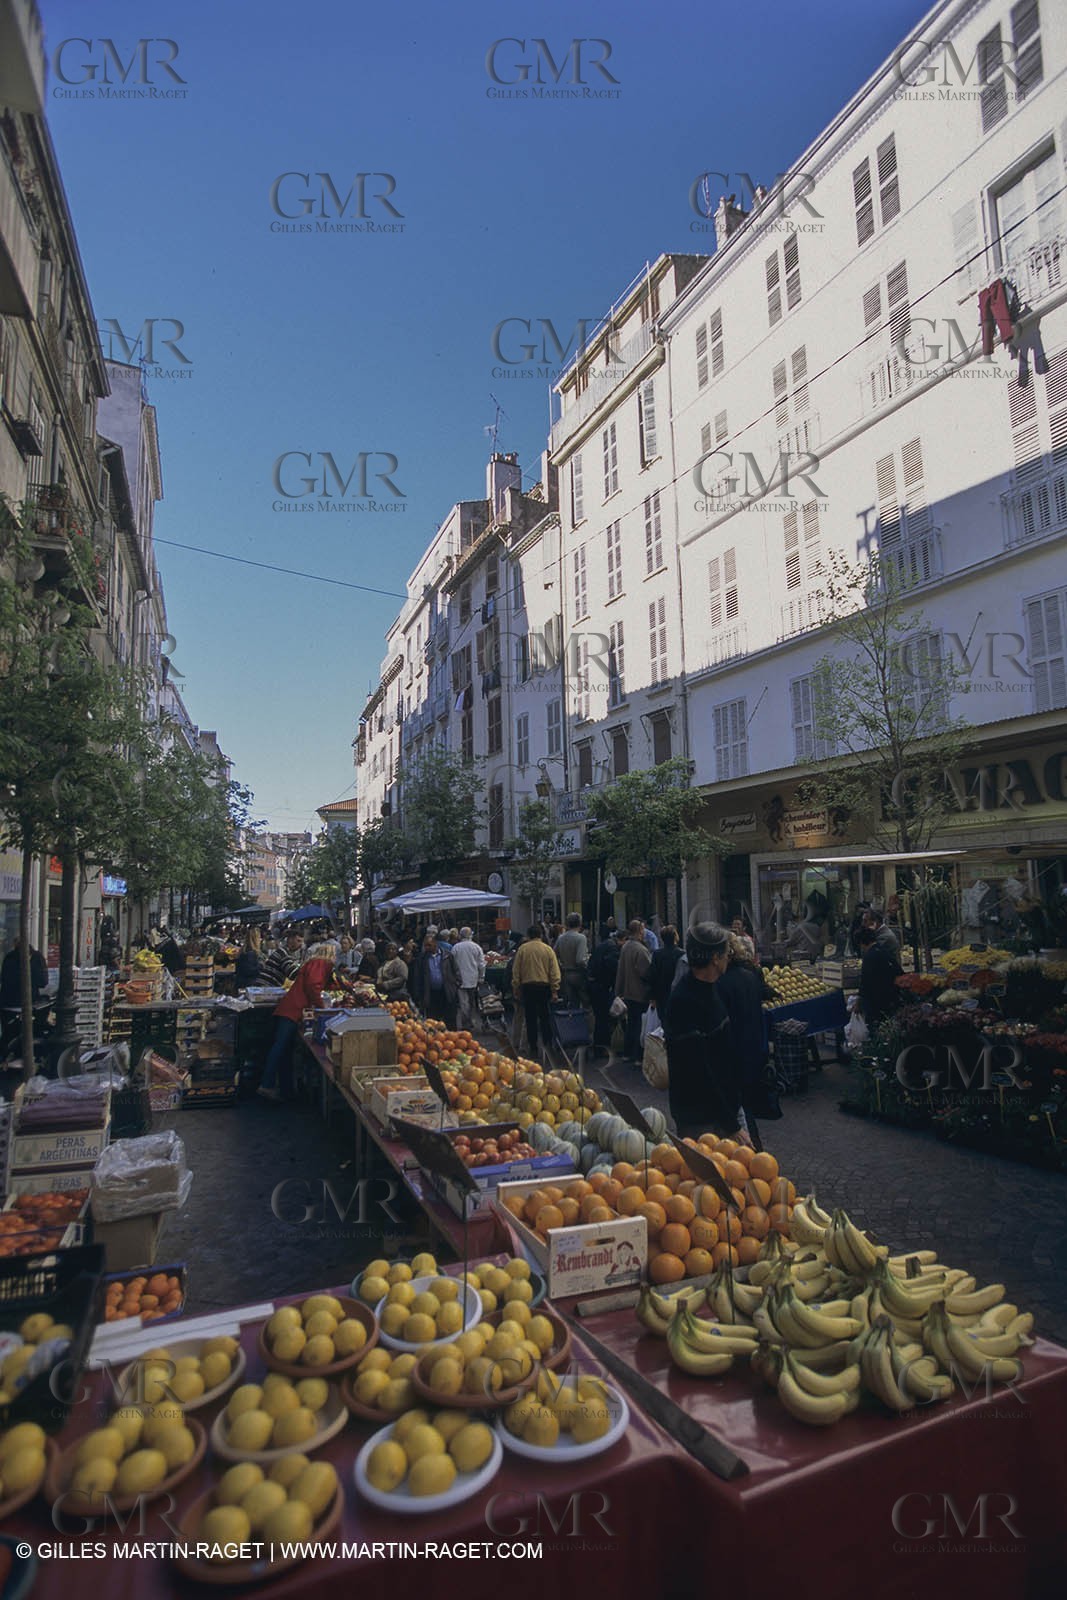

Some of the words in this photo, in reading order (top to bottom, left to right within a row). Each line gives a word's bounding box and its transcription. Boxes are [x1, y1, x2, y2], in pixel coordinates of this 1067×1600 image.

[56, 1136, 86, 1149] PERAS
[40, 1146, 99, 1161] ARGENTINAS
[52, 1177, 82, 1189] PERAS
[554, 1248, 614, 1275] Rembrandt
